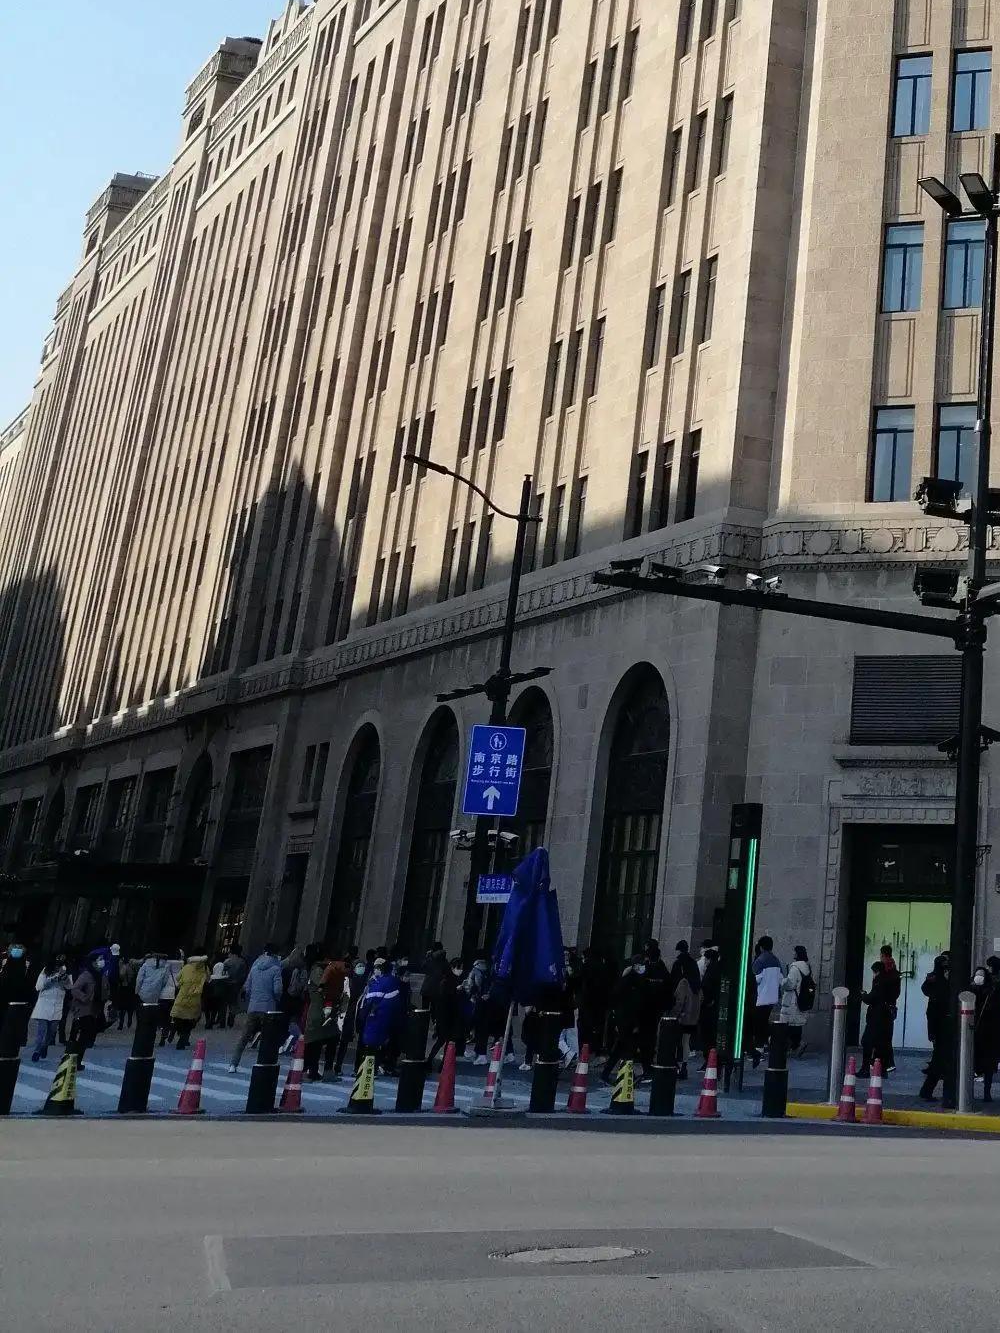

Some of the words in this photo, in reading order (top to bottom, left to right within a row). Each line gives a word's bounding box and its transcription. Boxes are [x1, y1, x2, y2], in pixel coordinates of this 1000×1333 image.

[473, 751, 518, 766] 南京路
[472, 764, 517, 779] 步行街
